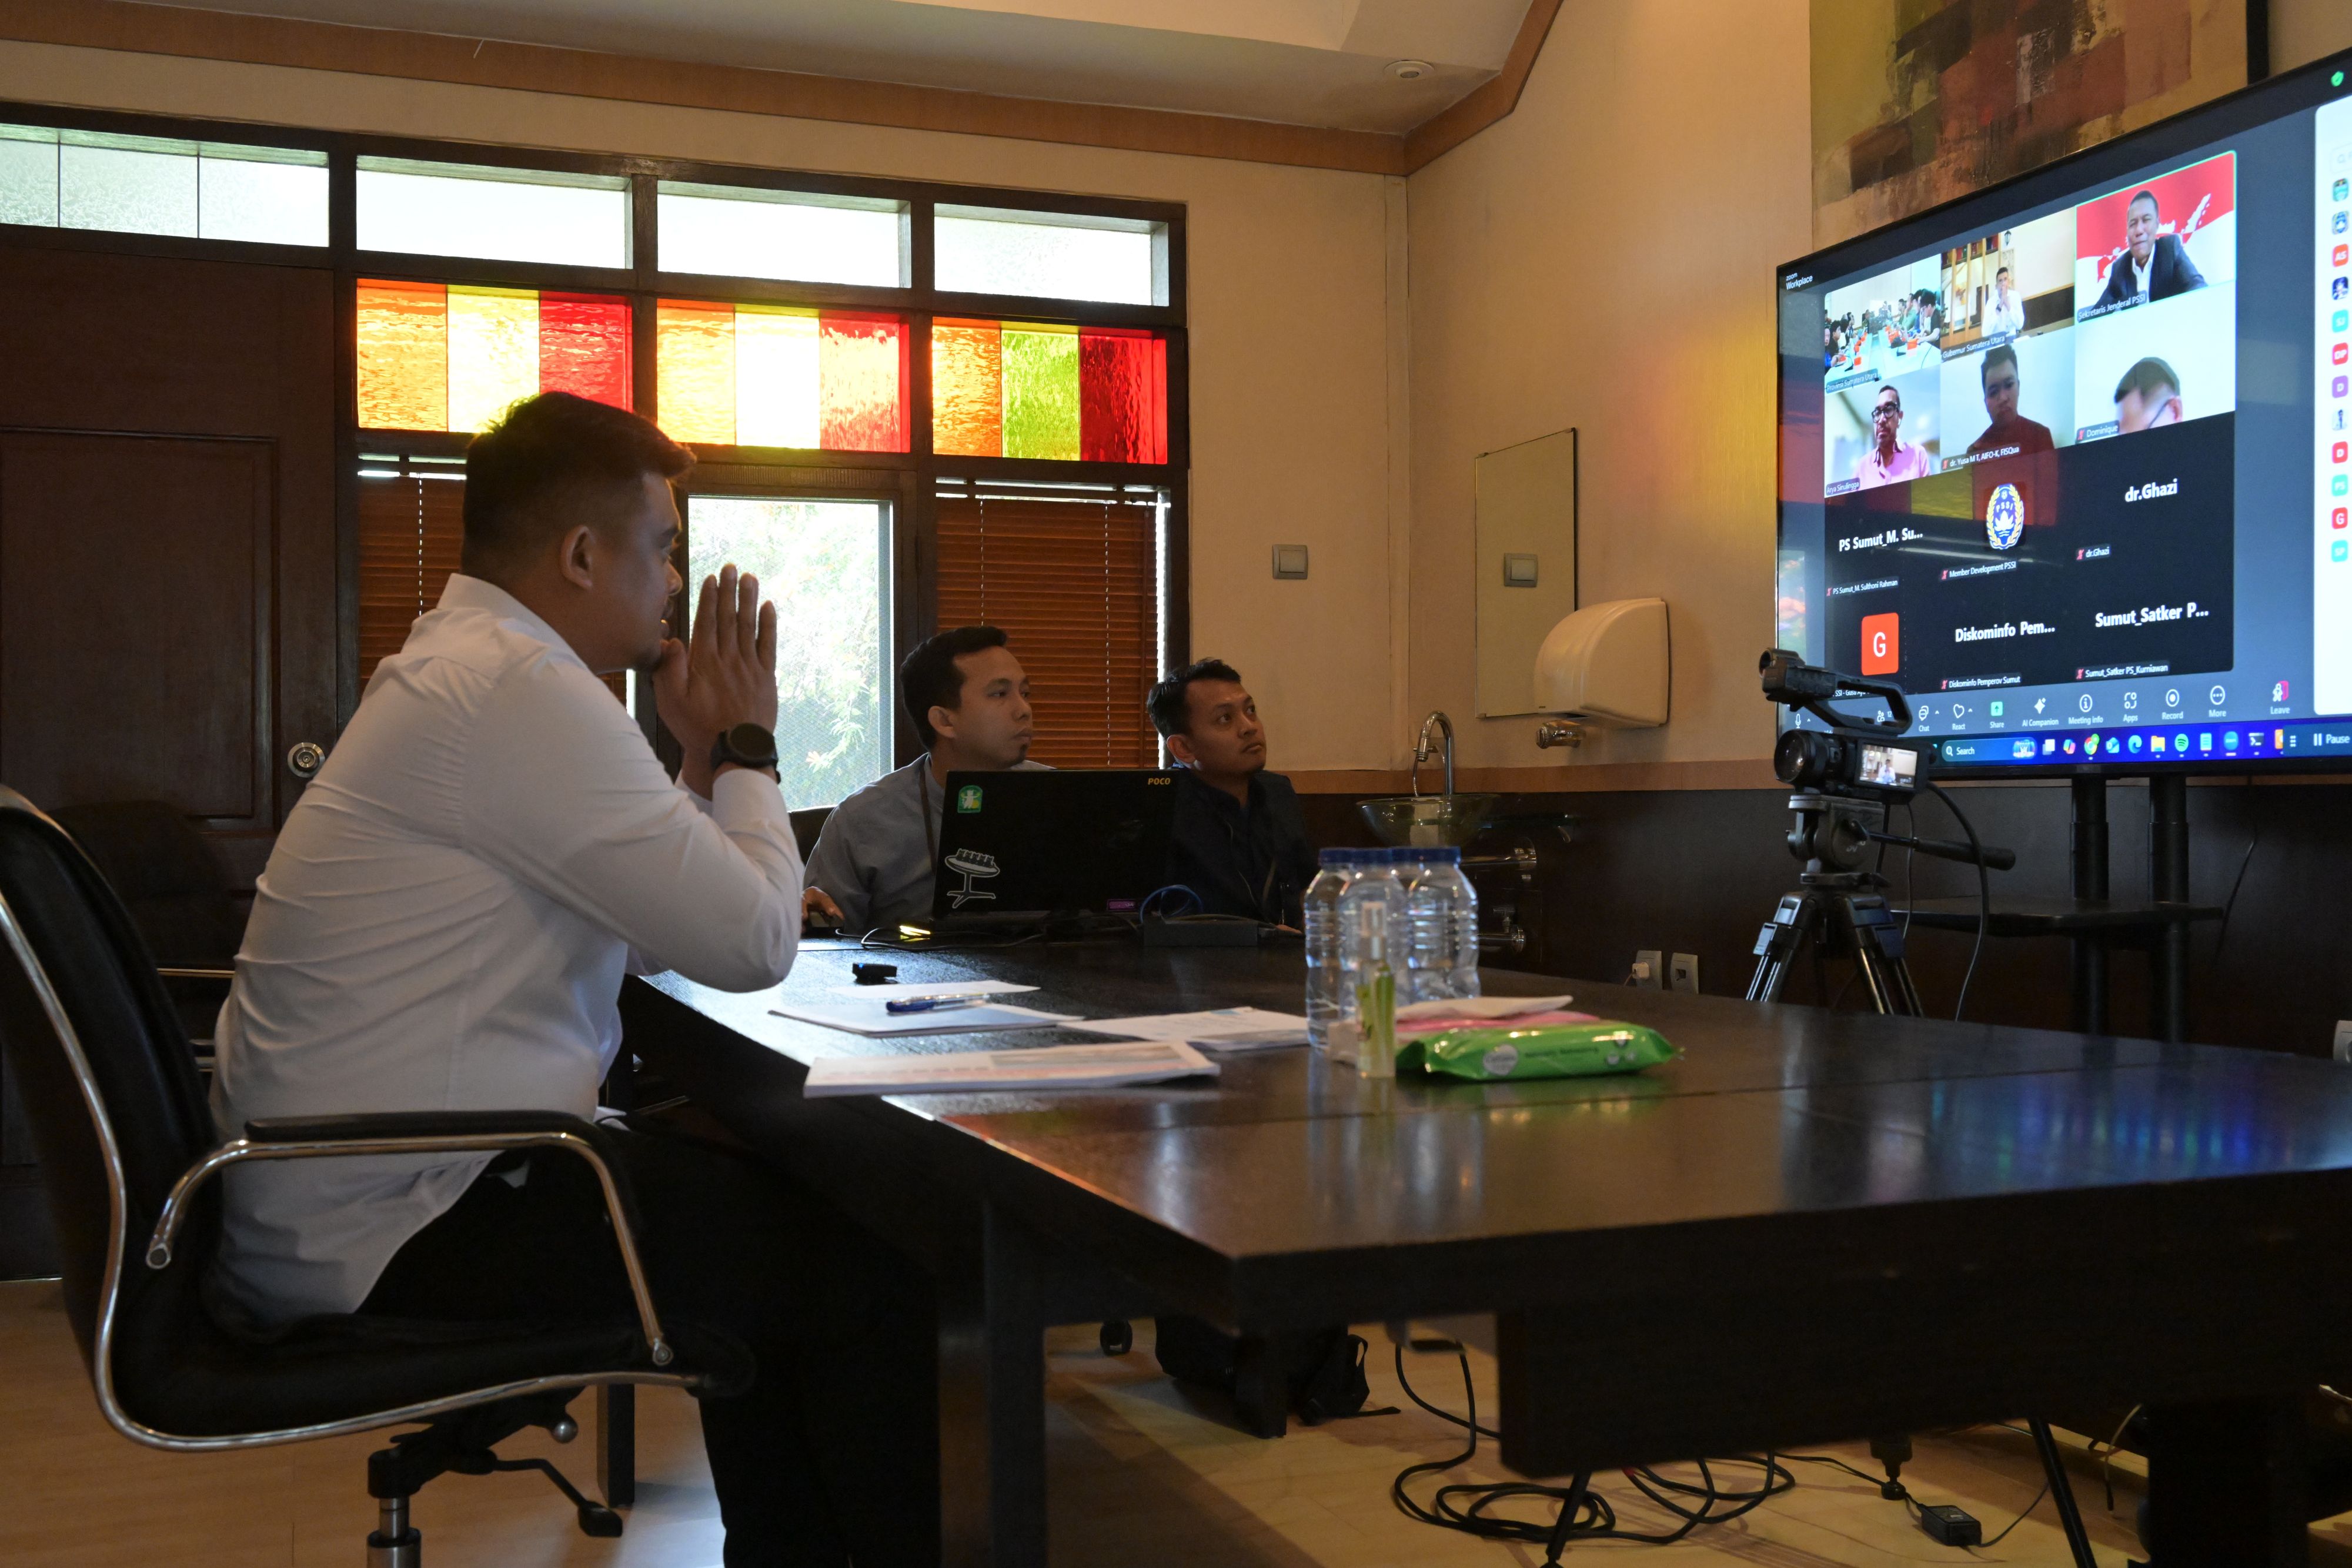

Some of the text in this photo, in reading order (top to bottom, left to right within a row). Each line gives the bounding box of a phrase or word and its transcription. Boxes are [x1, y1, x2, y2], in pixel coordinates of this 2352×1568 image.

[1786, 272, 1798, 281] zoom
[1786, 275, 1813, 290] Workplace
[2079, 294, 2146, 320] Sekretaris Jenderal PSSI
[1943, 336, 2005, 358] Gubernur Sumatera Utara
[1827, 381, 1844, 392] Provinsi
[1844, 376, 1865, 386] Sumatera
[2087, 424, 2119, 437] Dominique
[2000, 447, 2020, 456] FISQua
[1826, 482, 1859, 494] Arya Sinulingga
[2124, 478, 2178, 503] dr.Ghazi
[1996, 501, 2014, 513] PSSI
[2336, 513, 2345, 525] G
[1839, 538, 1850, 552] PS
[1853, 530, 1899, 549] Sumut_M.
[2086, 547, 2110, 558] dr.Ghazi
[1949, 561, 2016, 578] Member Development PSSI
[1860, 581, 1879, 591] Sulthoni
[1879, 580, 1898, 588] Rahman
[2095, 605, 2183, 627] Sumut_Satker
[1955, 623, 2016, 642] Diskominfo
[1873, 631, 1886, 657] G
[2085, 664, 2169, 677] Sumut_Satker PS_Kurniawan
[1949, 678, 1977, 688] Diskominfo
[2161, 711, 2183, 720] Record
[2209, 709, 2227, 718] More
[2270, 706, 2290, 715] Leave
[2022, 718, 2059, 727] AI Companion
[2069, 716, 2104, 725] Meeting info
[2123, 714, 2138, 723] Apps
[2326, 734, 2351, 744] Pause
[1956, 747, 1975, 755] Search
[1148, 777, 1171, 785] POCO
